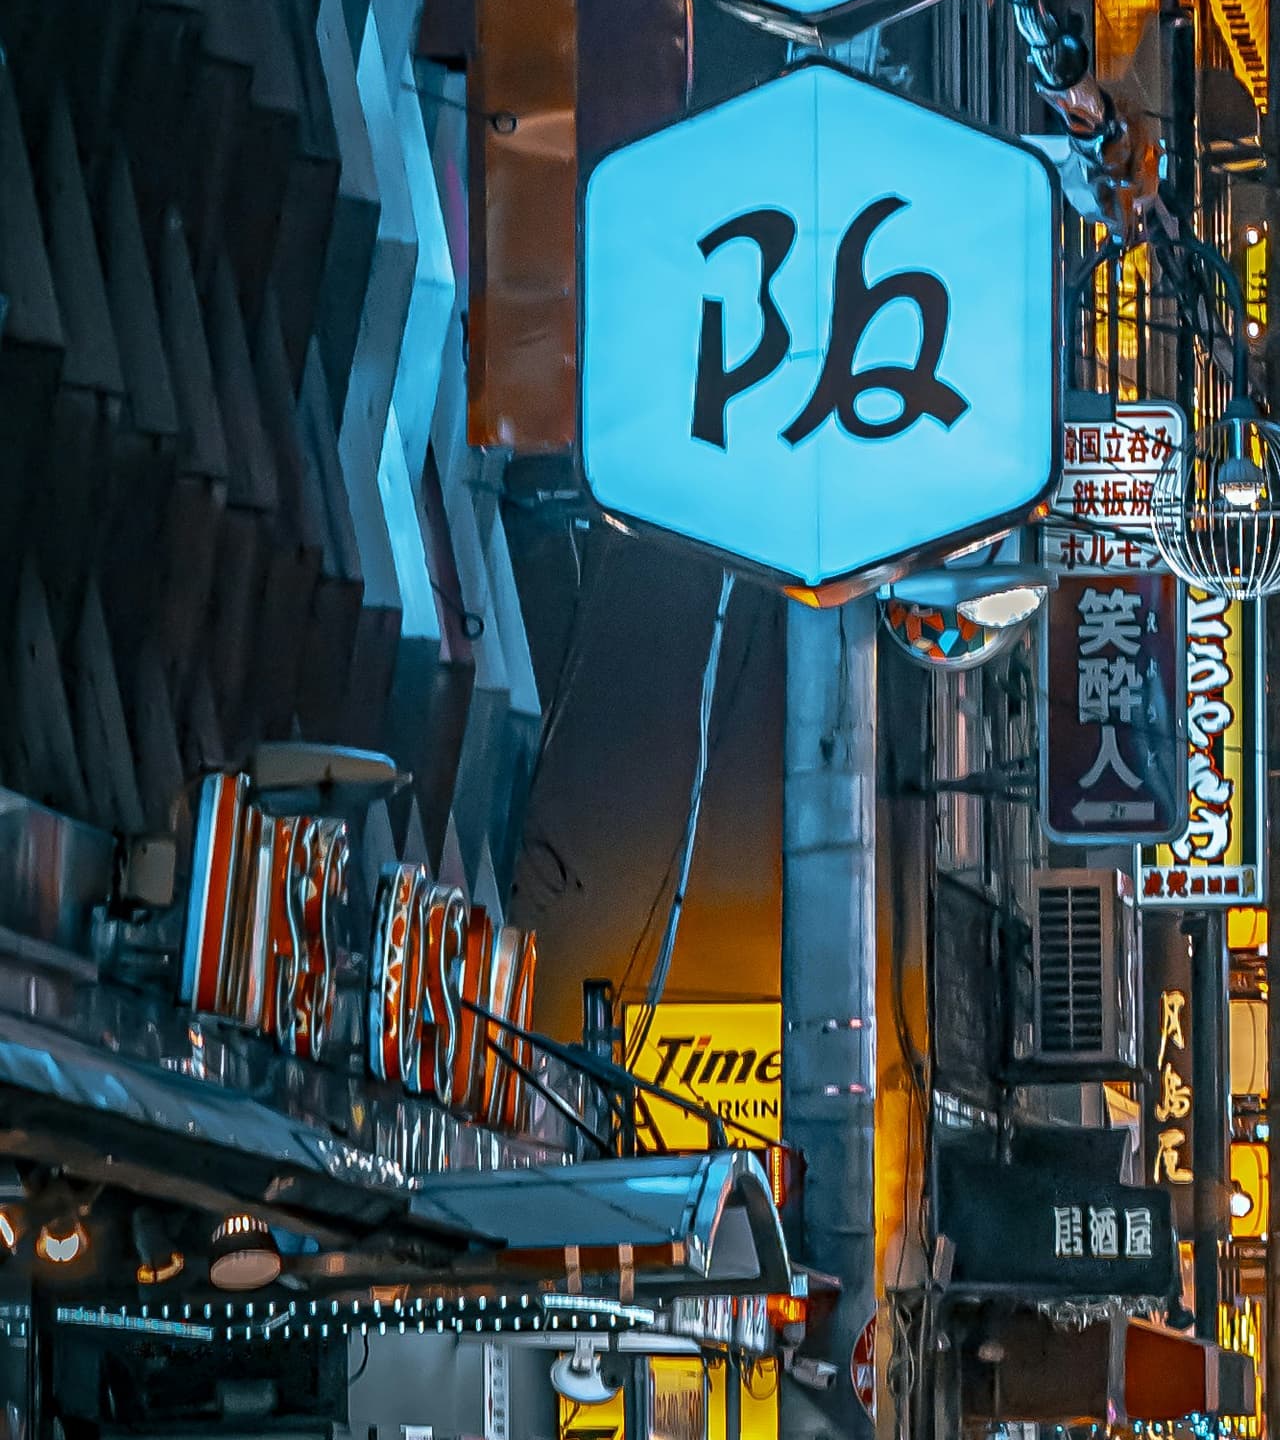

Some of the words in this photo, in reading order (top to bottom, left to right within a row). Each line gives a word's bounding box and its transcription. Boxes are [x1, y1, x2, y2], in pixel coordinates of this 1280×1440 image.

[1077, 587, 1145, 791] 笑酔人
[1054, 1206, 1152, 1259] 居酒屋
